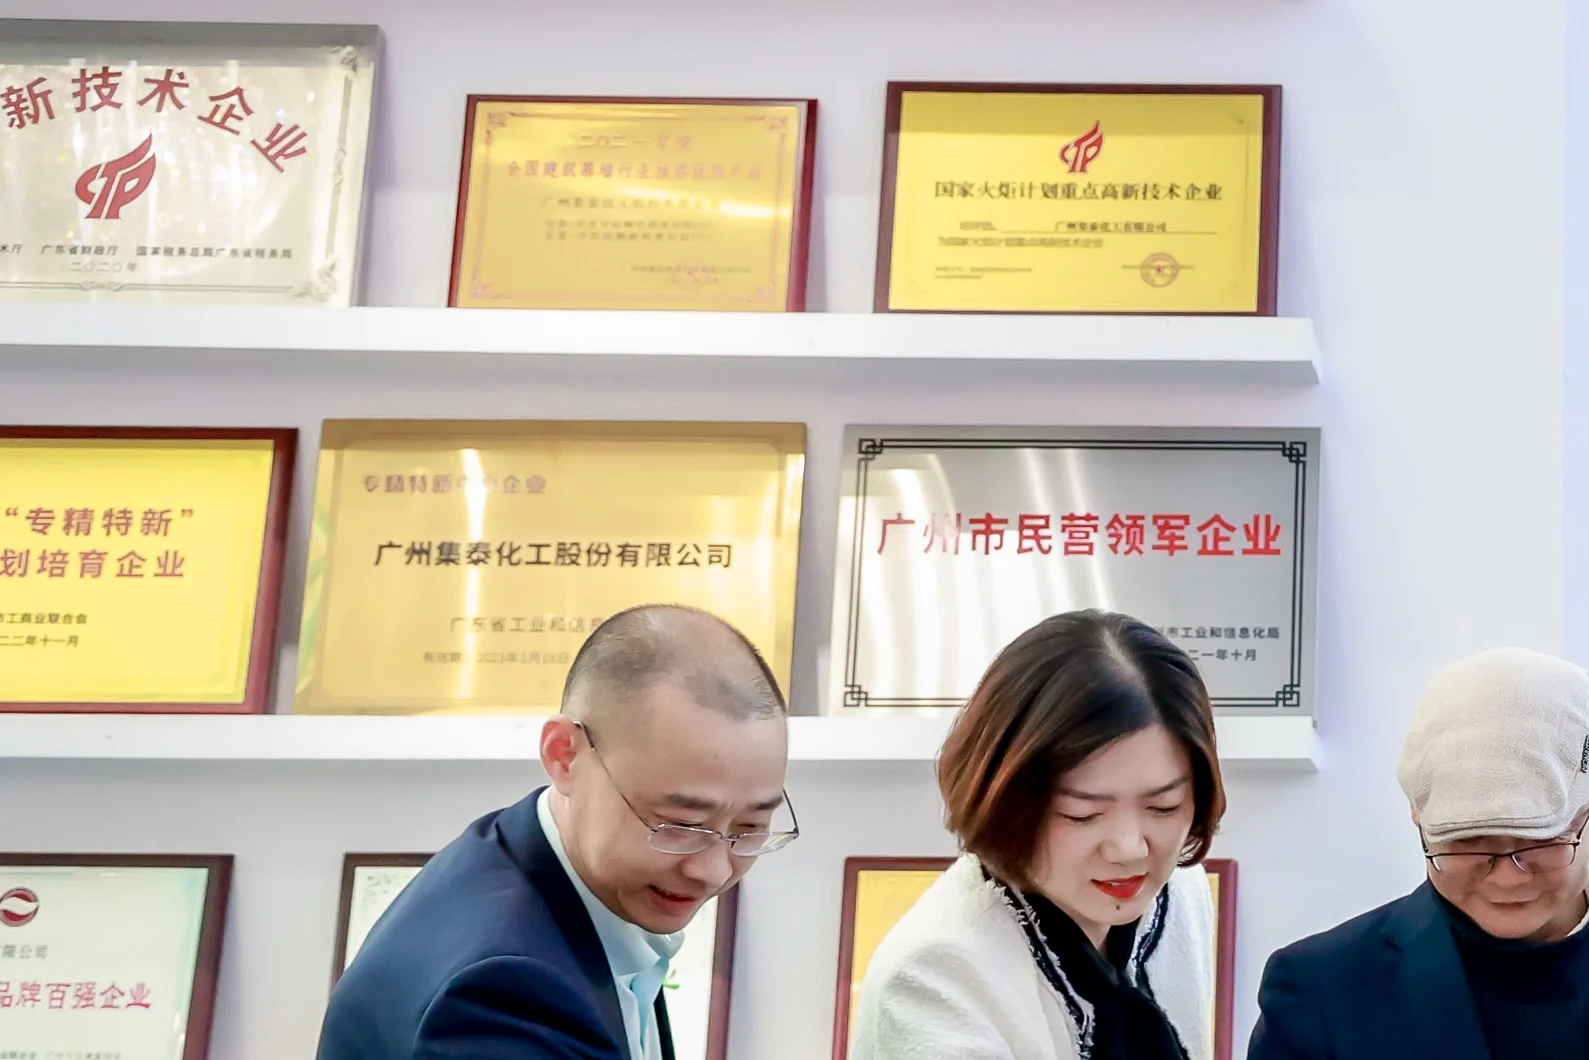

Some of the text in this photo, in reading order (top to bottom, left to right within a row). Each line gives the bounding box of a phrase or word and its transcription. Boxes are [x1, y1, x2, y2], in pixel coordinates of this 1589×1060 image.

[0, 66, 308, 172] 新技术企业
[934, 181, 1223, 201] 国家火炬计划重点高新技术企业
[877, 512, 1283, 556] 广州市民营领军企业
[0, 549, 186, 578] 划培育企业
[374, 541, 732, 568] 广州集泰化工股份有限公司
[0, 944, 48, 959] 限公司
[0, 981, 152, 1009] 品牌百强企业
